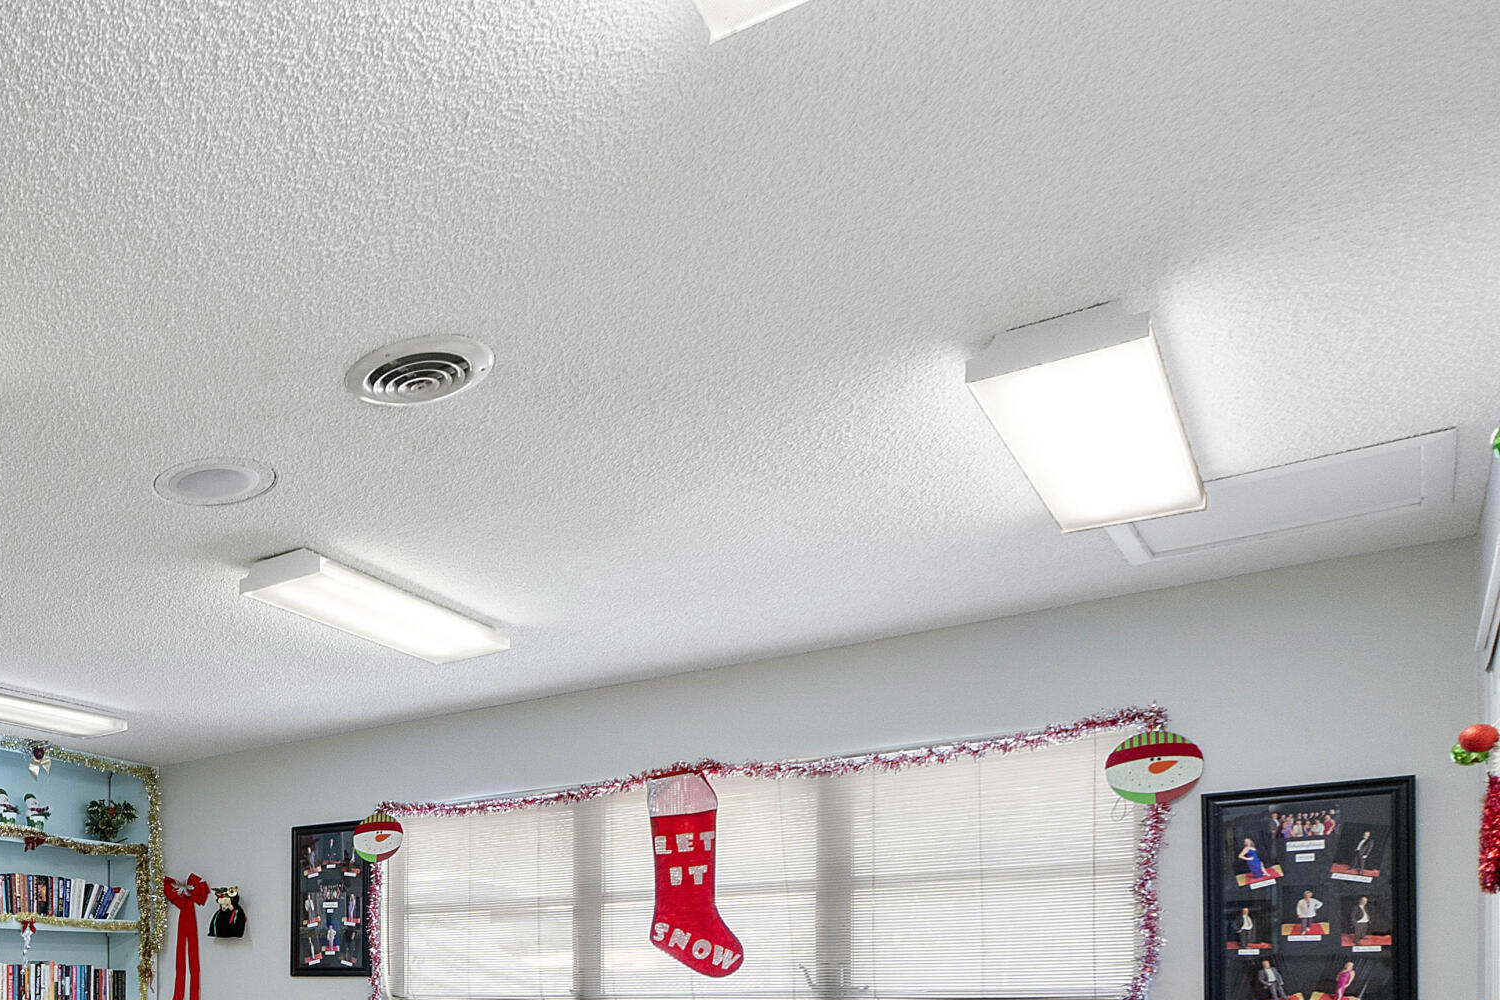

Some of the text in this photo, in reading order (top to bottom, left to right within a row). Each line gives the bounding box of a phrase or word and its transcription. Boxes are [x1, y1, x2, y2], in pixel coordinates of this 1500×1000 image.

[654, 831, 715, 855] LET
[669, 865, 708, 886] IT
[653, 922, 741, 970] SNOW
